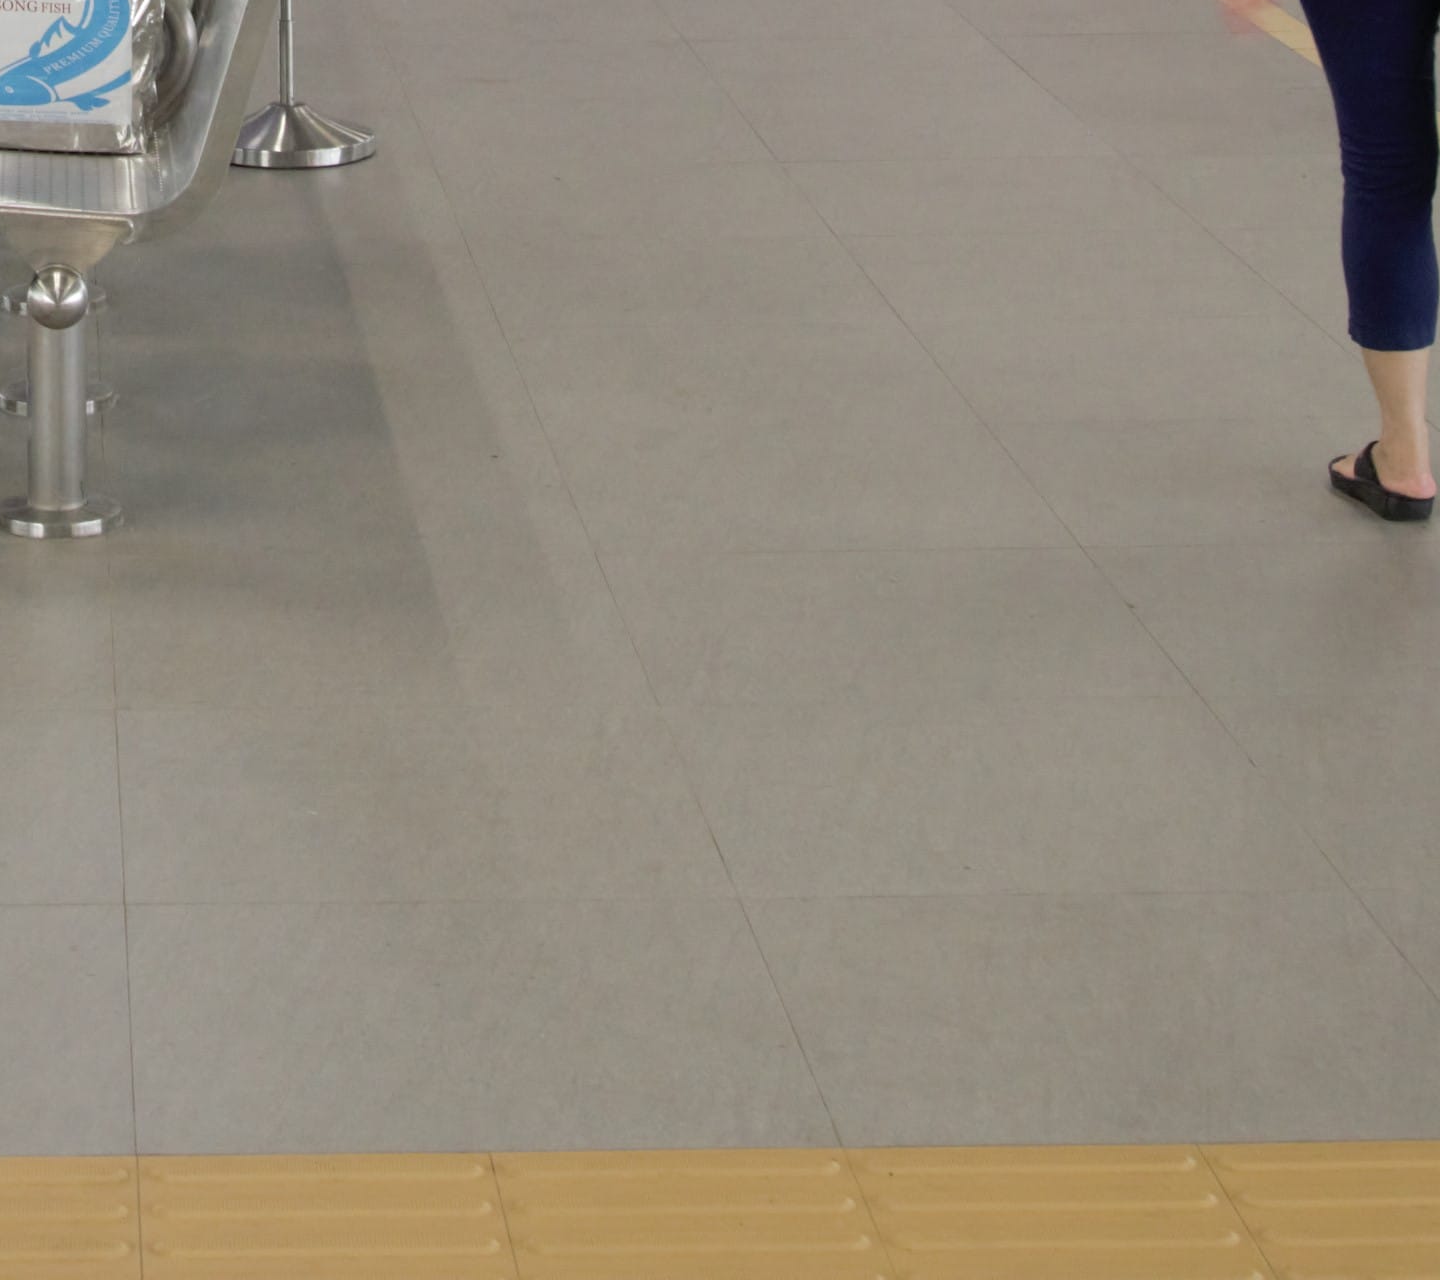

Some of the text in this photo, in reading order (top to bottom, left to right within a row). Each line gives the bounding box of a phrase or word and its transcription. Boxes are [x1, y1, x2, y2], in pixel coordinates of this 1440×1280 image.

[41, 2, 71, 14] FISH
[43, 34, 103, 75] PREMIUM
[98, 0, 120, 41] QUALITY
